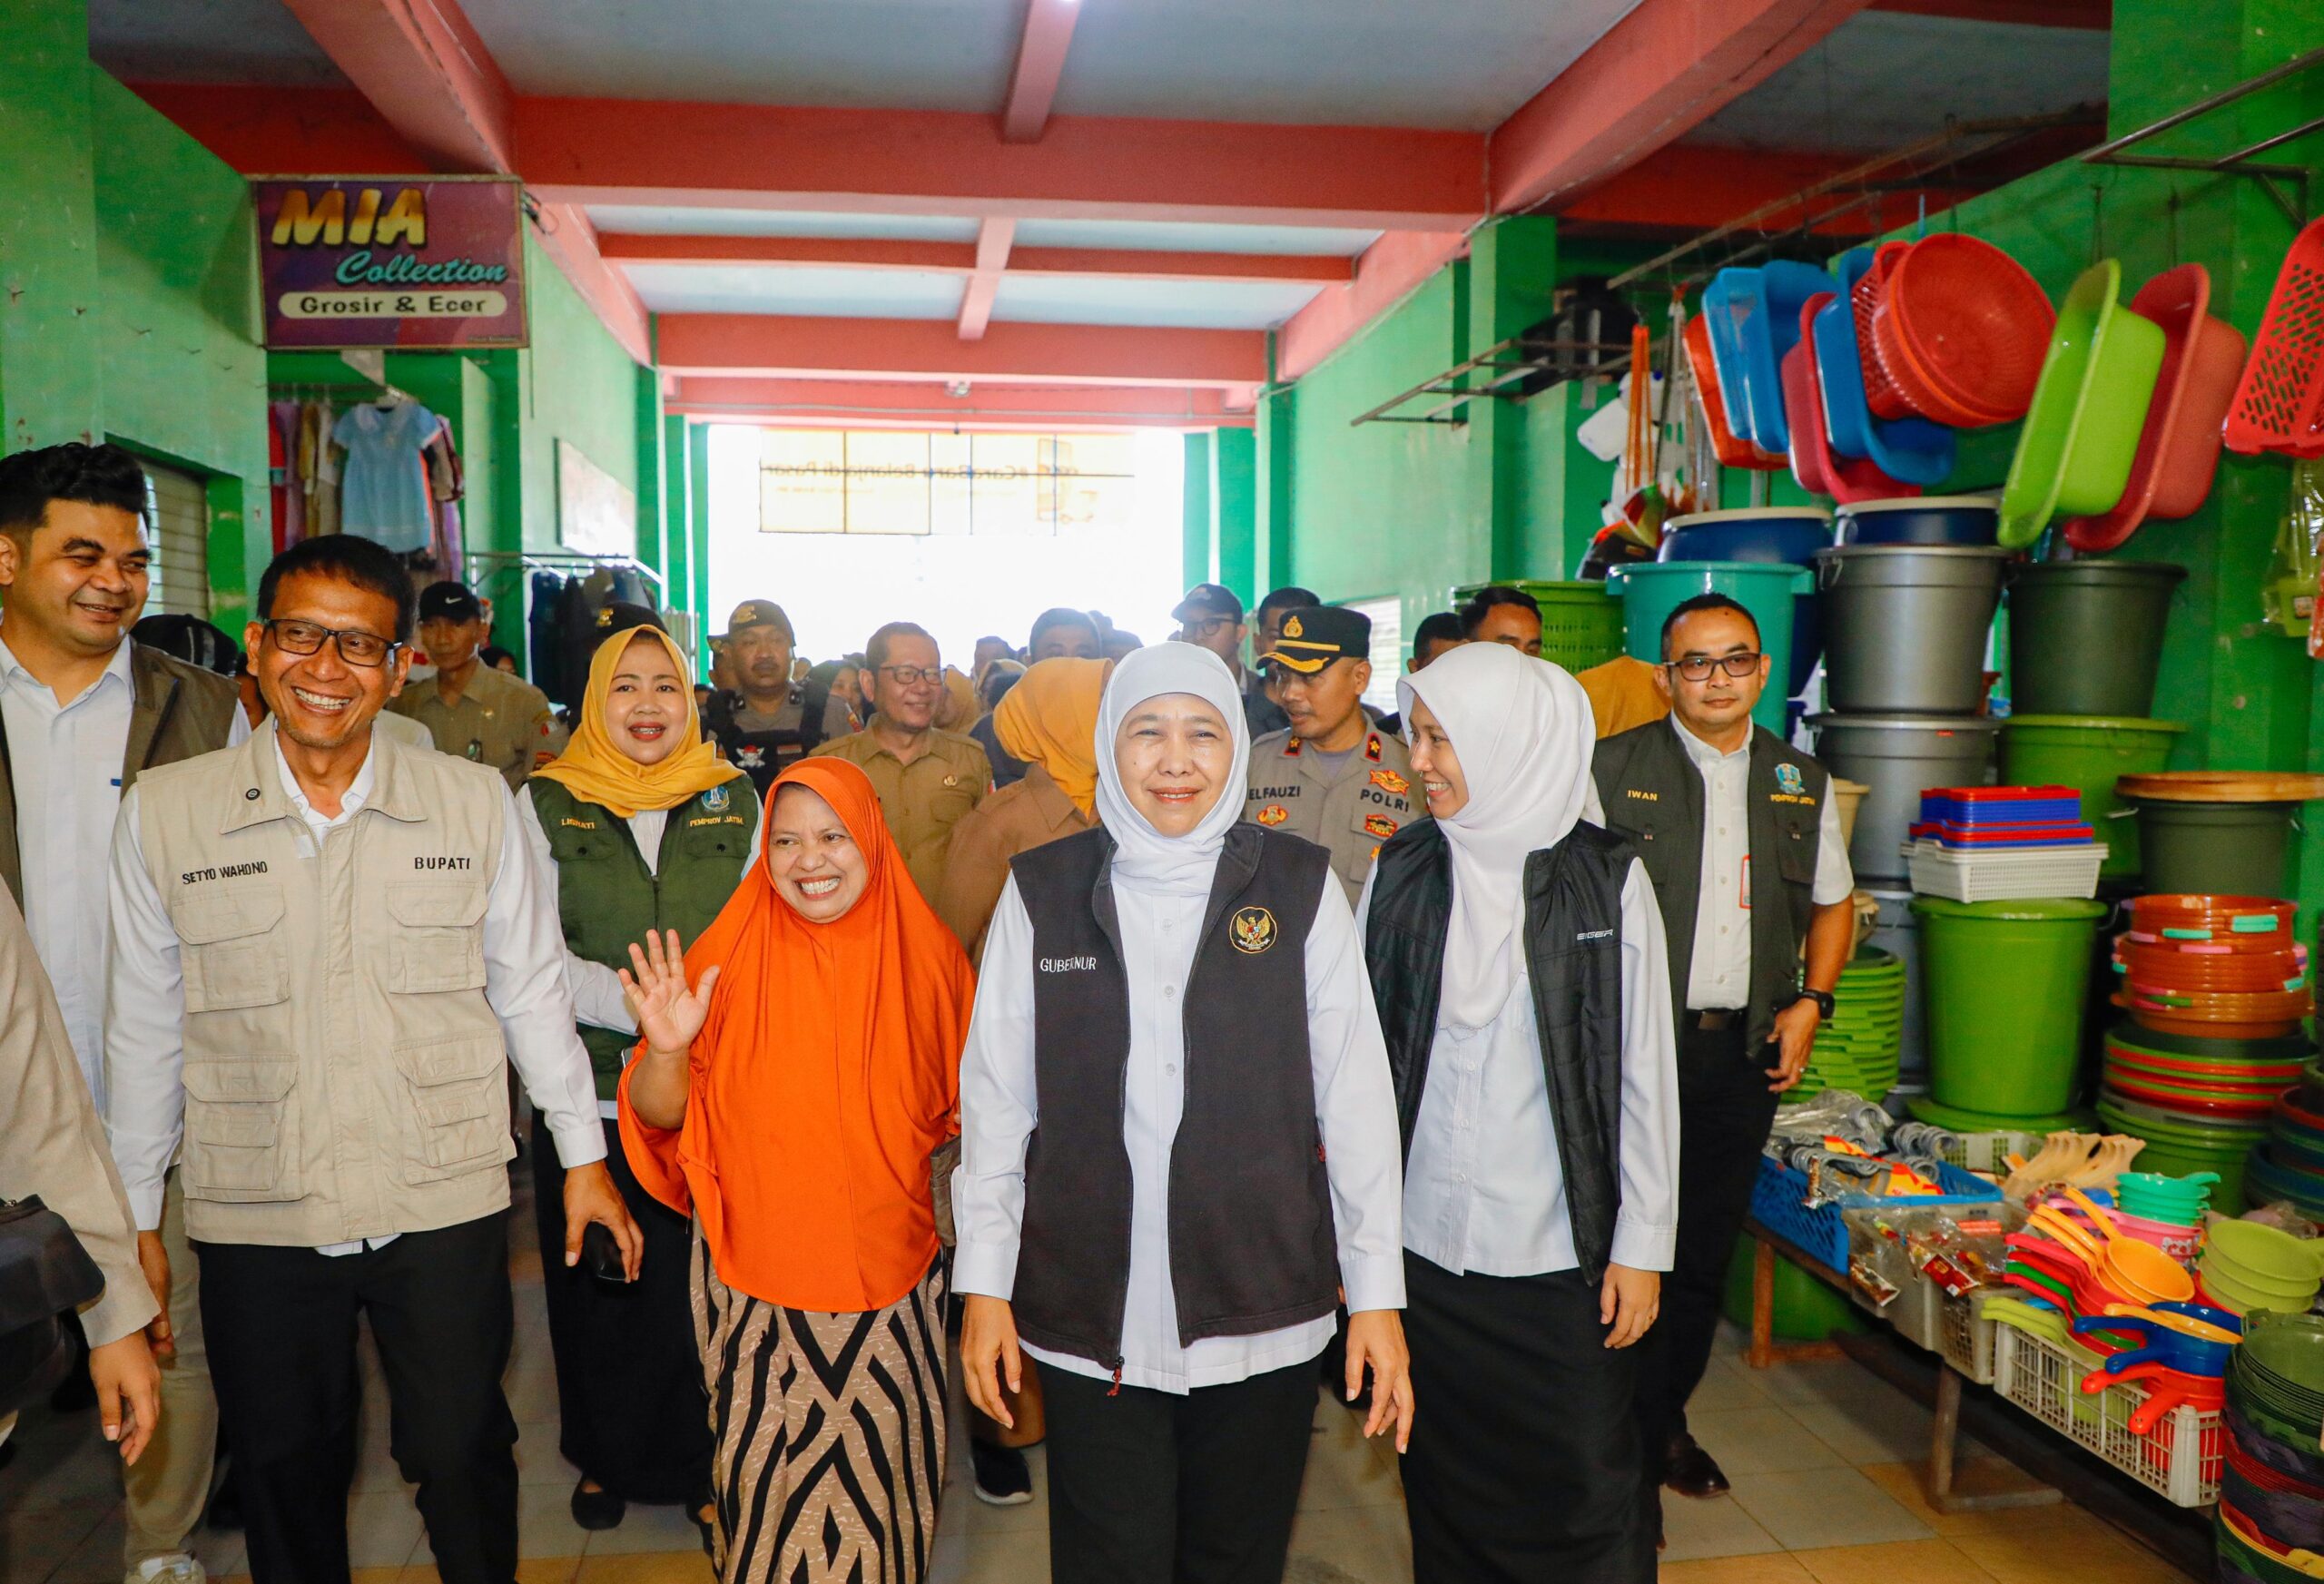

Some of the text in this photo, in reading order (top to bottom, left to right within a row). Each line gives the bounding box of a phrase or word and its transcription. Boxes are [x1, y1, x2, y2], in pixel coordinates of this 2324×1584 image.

[271, 187, 427, 246] MIA
[335, 250, 508, 284] Collection
[300, 296, 487, 313] Grosir & Ecer
[1248, 785, 1301, 801] ELFAUZI
[1360, 788, 1409, 813] POLRI
[1627, 789, 1659, 802] IWAN
[689, 814, 744, 827] PEMPROV JATIM
[414, 856, 471, 871] BUPATI
[182, 861, 269, 885] SETYO WAHONO
[1039, 956, 1098, 974] GUBERNUR
